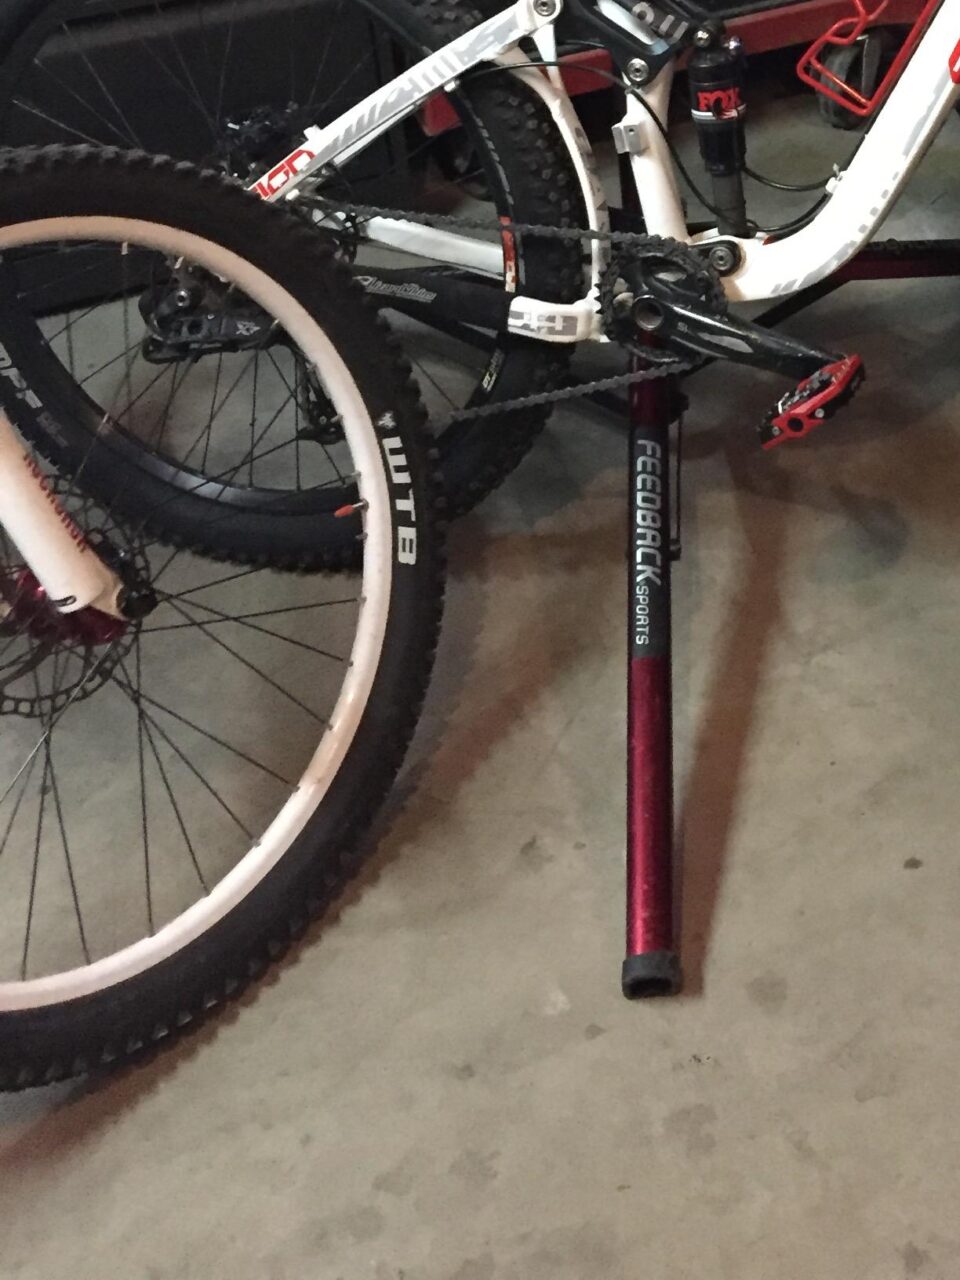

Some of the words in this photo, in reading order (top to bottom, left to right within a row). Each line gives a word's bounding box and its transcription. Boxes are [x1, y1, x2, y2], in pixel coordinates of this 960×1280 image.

[697, 86, 744, 111] FOX
[382, 436, 416, 566] WTB
[636, 439, 661, 586] FEEDBACK
[635, 585, 649, 645] SPORTS
